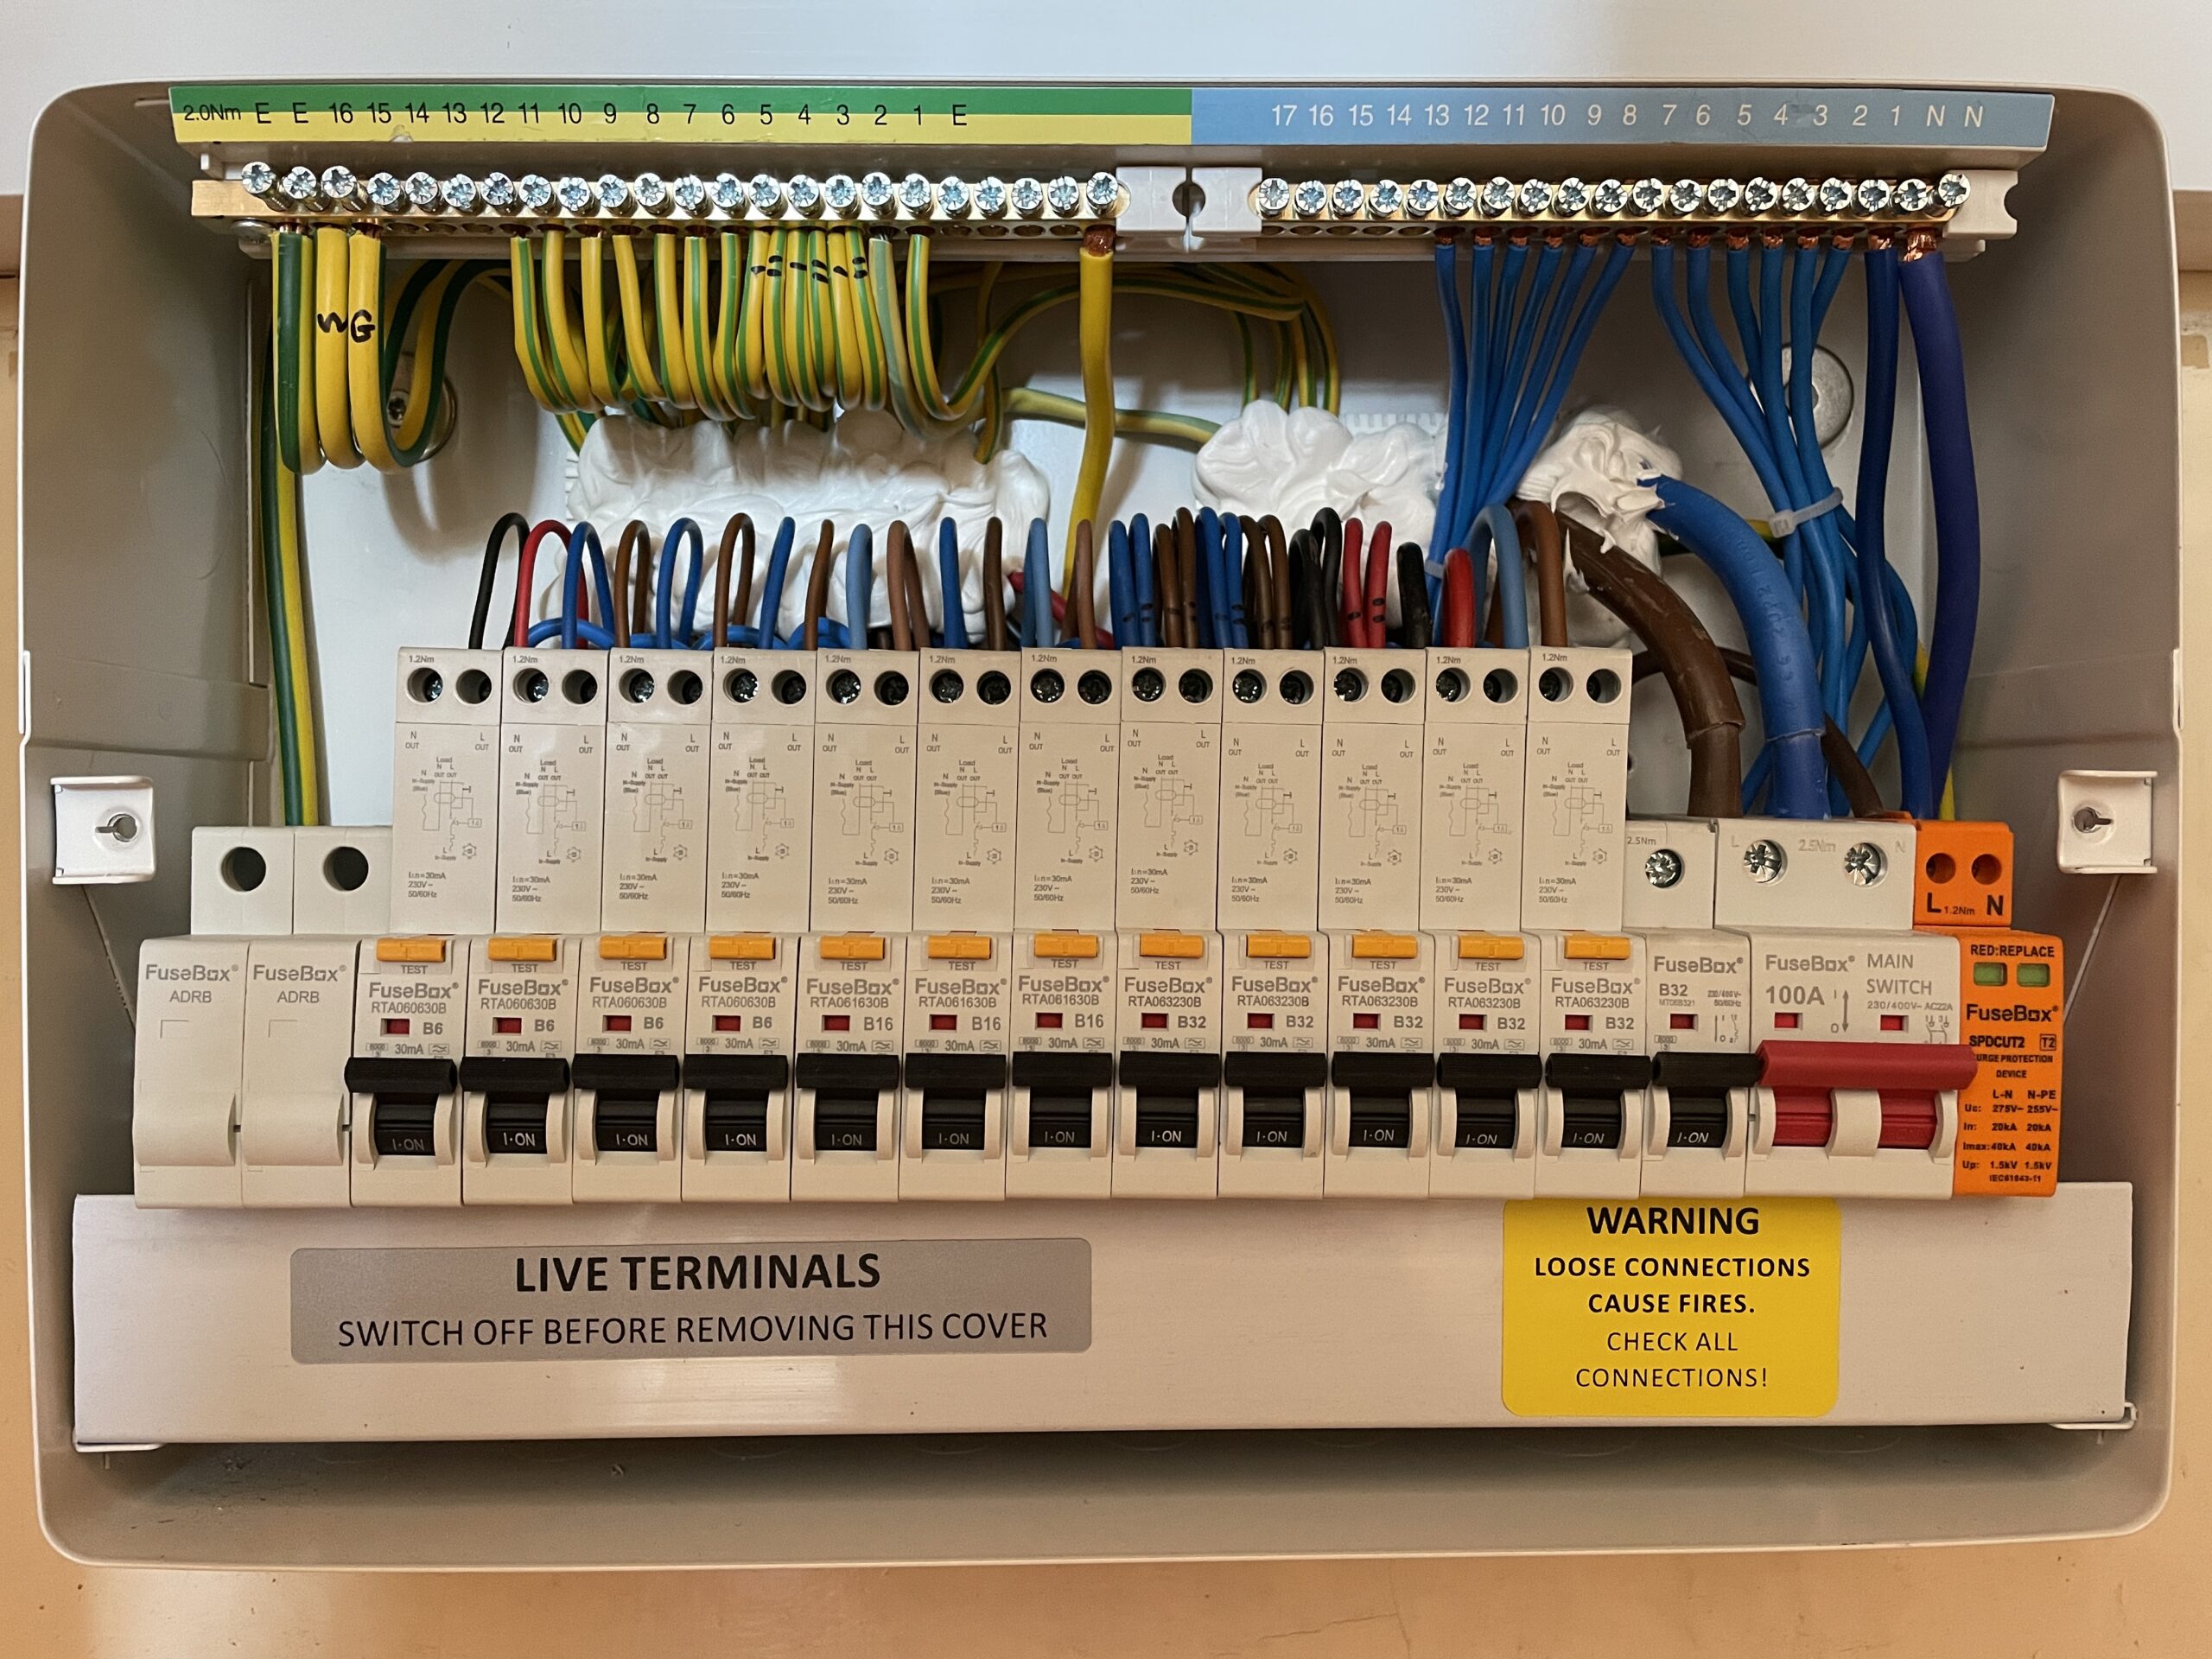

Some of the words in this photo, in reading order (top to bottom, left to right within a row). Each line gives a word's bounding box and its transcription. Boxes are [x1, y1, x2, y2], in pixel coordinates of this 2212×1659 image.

[184, 104, 241, 122] 2.0Nm
[255, 103, 271, 124] E
[294, 103, 308, 124] E
[330, 103, 353, 124] 16
[367, 103, 391, 124] 15
[404, 103, 429, 124] 14
[442, 103, 467, 124] 13
[480, 103, 505, 124] 12
[519, 103, 539, 124] 11
[558, 103, 582, 124] 10
[604, 103, 616, 124] 9
[647, 103, 659, 124] 8
[683, 105, 696, 126] 7
[721, 105, 734, 126] 6
[760, 105, 773, 126] 5
[798, 105, 811, 126] 4
[836, 105, 850, 126] 3
[874, 105, 887, 126] 2
[914, 105, 921, 126] 1
[952, 105, 967, 126] E
[1272, 105, 1297, 125] 17
[1309, 105, 1333, 125] 16
[1349, 105, 1373, 125] 15
[1388, 105, 1411, 125] 14
[1425, 105, 1449, 125] 13
[1465, 105, 1489, 125] 12
[1503, 104, 1523, 125] 11
[1541, 105, 1565, 125] 10
[1588, 105, 1601, 125] 9
[1624, 105, 1636, 125] 8
[1663, 105, 1676, 124] 7
[1697, 105, 1710, 125] 6
[1738, 105, 1751, 125] 5
[1774, 105, 1788, 125] 4
[1814, 105, 1827, 125] 3
[1853, 105, 1867, 125] 2
[1891, 105, 1899, 125] 1
[1927, 105, 1945, 126] N
[1965, 106, 1982, 127] N
[1541, 653, 1567, 663] 1.2Nm
[1627, 836, 1656, 845] 2.5Nm
[1927, 893, 1942, 912] L
[1944, 906, 1974, 915] 1.2Nm
[1987, 895, 2003, 916] N
[1971, 944, 2054, 957] RED:REPLACE
[621, 962, 647, 970] TEST
[730, 961, 756, 969] TEST
[841, 962, 868, 970] TEST
[949, 962, 976, 970] TEST
[1052, 959, 1078, 968] TEST
[1155, 961, 1181, 969] TEST
[1263, 961, 1289, 969] TEST
[1370, 961, 1396, 969] TEST
[1475, 962, 1501, 970] TEST
[1583, 962, 1609, 970] TEST
[1868, 954, 1913, 969] MAIN
[401, 965, 428, 974] TEST
[512, 964, 537, 973] TEST
[1660, 983, 1688, 996] B32
[1867, 979, 1931, 995] SWITCH
[169, 990, 212, 1003] ADRB
[277, 991, 319, 1003] ADRB
[702, 995, 775, 1007] RTA060630B
[919, 996, 996, 1007] RTA061630B
[1023, 994, 1099, 1005] RTA061630B
[1128, 996, 1201, 1007] RTA063230B
[1237, 995, 1309, 1007] RTA063230B
[1343, 995, 1418, 1007] RTA063230B
[1766, 986, 1825, 1005] 100A
[372, 1001, 446, 1014] RTA060630B
[481, 998, 556, 1010] RTA060630B
[593, 996, 666, 1008] RTA060630B
[810, 997, 888, 1007] RTA061630B
[1449, 997, 1520, 1008] RTA063230B
[1555, 996, 1629, 1008] RTA063230B
[535, 1020, 554, 1032] B6
[644, 1017, 664, 1029] B6
[753, 1016, 772, 1028] B6
[864, 1017, 893, 1031] B16
[972, 1016, 1001, 1030] B16
[1076, 1014, 1103, 1027] B16
[1179, 1016, 1205, 1028] B32
[1287, 1015, 1313, 1027] B32
[1395, 1016, 1423, 1028] B32
[1498, 1017, 1525, 1030] B32
[1606, 1017, 1634, 1029] B32
[423, 1022, 442, 1034] B6
[506, 1041, 535, 1052] 30mA
[616, 1039, 645, 1049] 30mA
[726, 1038, 753, 1049] 30mA
[837, 1041, 866, 1051] 30mA
[945, 1040, 975, 1051] 30mA
[1049, 1038, 1077, 1048] 30mA
[1151, 1038, 1179, 1048] 30mA
[1261, 1037, 1288, 1047] 30mA
[1366, 1038, 1395, 1048] 30mA
[1471, 1039, 1499, 1050] 30mA
[1579, 1039, 1607, 1049] 30mA
[1970, 1036, 2024, 1047] SPDCUT2
[2043, 1037, 2055, 1048] T2
[395, 1044, 423, 1054] 30mA
[2001, 1054, 2053, 1063] PROTECTION
[1993, 1090, 2012, 1099] L-N
[2028, 1090, 2056, 1099] N-PE
[2025, 1161, 2051, 1170] 1.5kV
[1586, 1207, 1758, 1235] WARNING
[1536, 1257, 1615, 1276] LOOSE
[1625, 1258, 1809, 1276] CONNECTIONS
[517, 1257, 607, 1292] LIVE
[621, 1254, 880, 1290] TERMINALS
[1589, 1294, 1669, 1313] CAUSE
[1680, 1294, 1754, 1313] FIRES.
[339, 1320, 462, 1346] SWITCH
[474, 1319, 533, 1345] OFF
[545, 1318, 665, 1344] BEFORE
[678, 1315, 853, 1343] REMOVING
[863, 1314, 932, 1339] THIS
[943, 1313, 1046, 1338] COVER
[1608, 1332, 1687, 1351] CHECK
[1696, 1332, 1738, 1351] ALL
[1577, 1368, 1765, 1387] CONNECTIONS!
